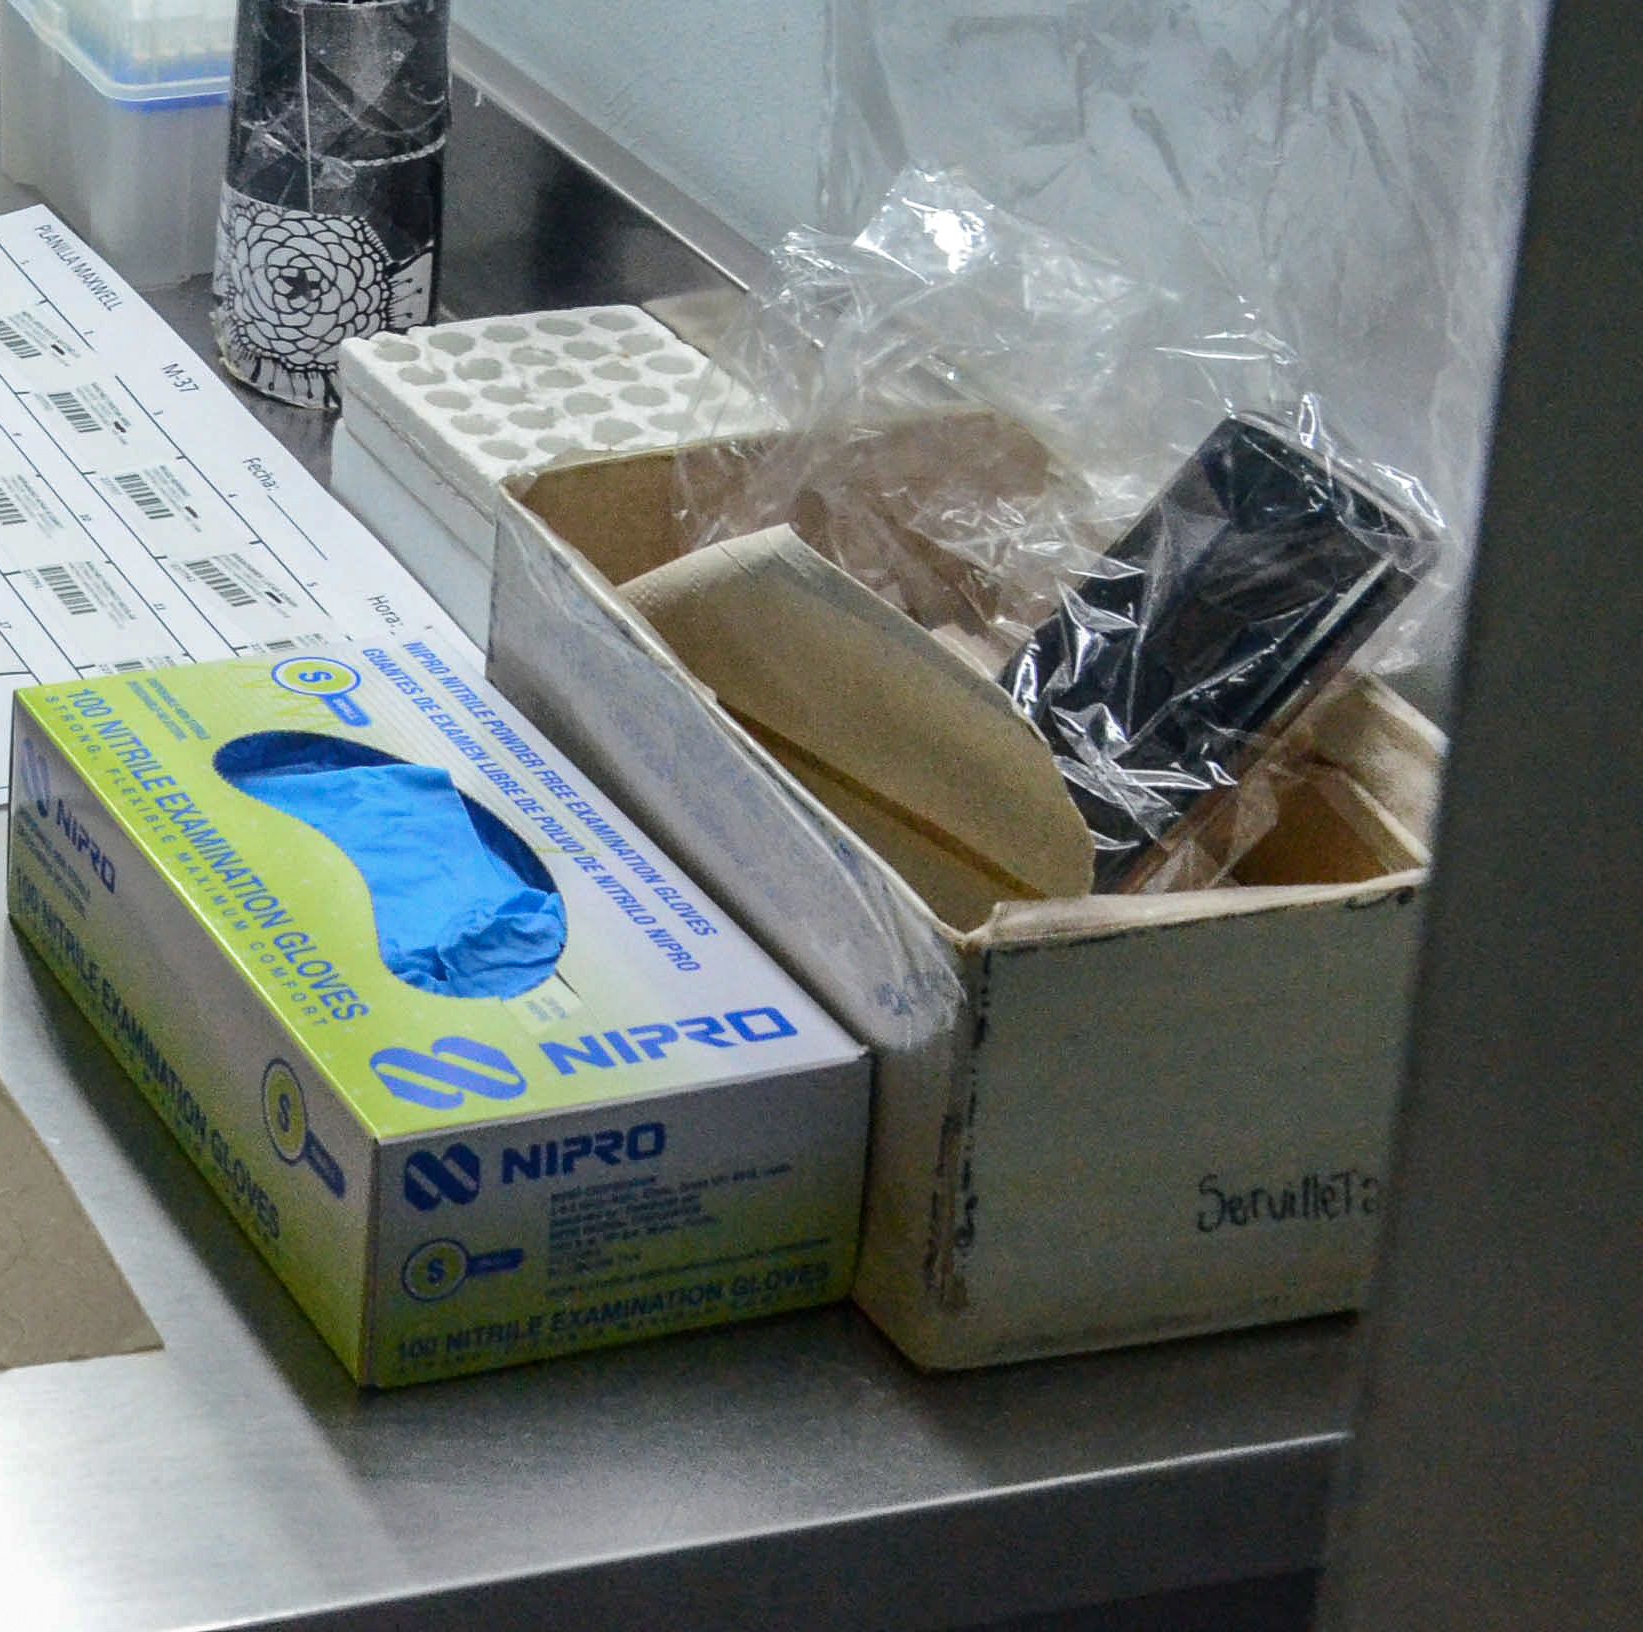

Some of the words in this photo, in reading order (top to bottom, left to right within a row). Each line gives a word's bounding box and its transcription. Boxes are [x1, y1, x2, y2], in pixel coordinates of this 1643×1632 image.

[35, 224, 80, 271] PLANILLA
[75, 263, 124, 312] MAXWELL
[162, 362, 200, 393] M-37
[243, 456, 280, 492] Fecha:
[298, 670, 333, 683] S
[363, 648, 426, 697] GUANTES
[412, 696, 441, 714] DE
[427, 714, 487, 762] EXAMEN
[477, 759, 526, 797] LIBRE
[514, 796, 545, 815] DE
[533, 815, 586, 855] POLVO
[573, 854, 607, 875] DE
[592, 874, 656, 927] NITRILO
[645, 927, 702, 974] NIPRO
[402, 641, 453, 676] NIPRO
[439, 676, 497, 720] NITRILE
[483, 719, 545, 769] POWDER
[534, 769, 579, 800] FREE
[566, 800, 666, 885] EXAMINATION
[654, 886, 718, 938] GLOVES
[56, 798, 116, 894] NIPRO
[67, 687, 113, 719] 100
[98, 718, 177, 793] NITRILE
[154, 791, 294, 930] EXAMINATION
[273, 930, 370, 1022] GLOVES
[108, 767, 177, 845] FLEXIBLE
[177, 850, 250, 932] MAXIMUM
[250, 940, 328, 1027] COMFORT
[538, 1006, 799, 1076] NIPRO
[501, 1122, 667, 1185] NIPRO
[426, 1257, 445, 1286] S
[445, 1314, 543, 1353] NITRILE
[551, 1282, 727, 1332] EXAMINATION
[729, 1260, 832, 1299] GLOVES
